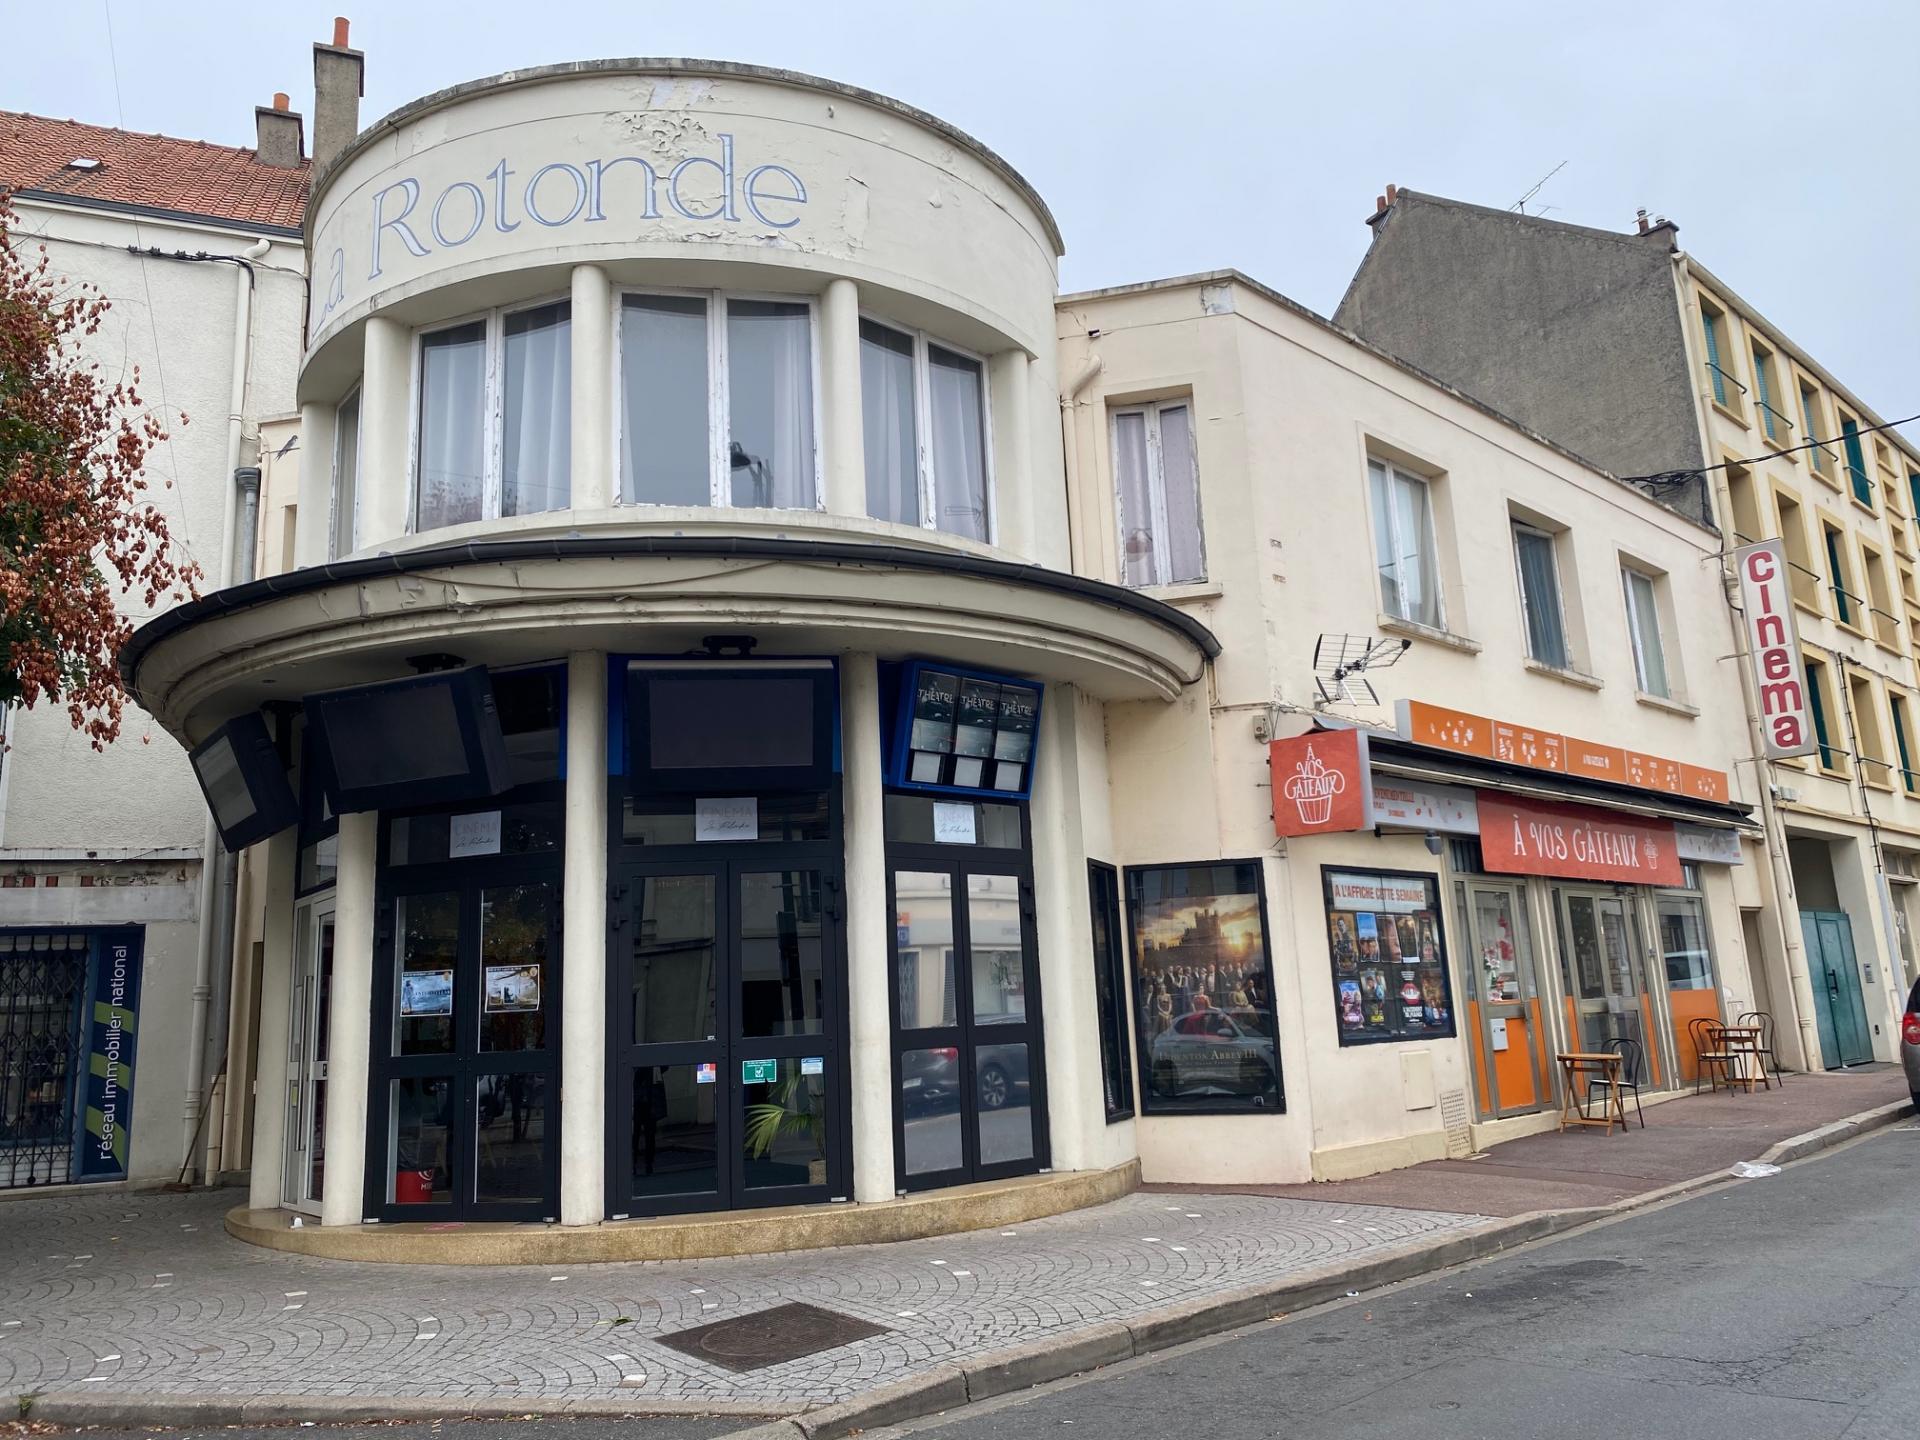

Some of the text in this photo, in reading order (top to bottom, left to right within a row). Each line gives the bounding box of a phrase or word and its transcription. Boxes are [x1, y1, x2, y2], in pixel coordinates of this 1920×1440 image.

[368, 133, 808, 281] Rotonde
[1296, 759, 1325, 779] VOS
[1513, 814, 1641, 868] À VOS GÂTEAUX
[1342, 885, 1375, 900] L'AFFICHE
[1376, 887, 1394, 901] CETTE
[1395, 889, 1424, 903] SEMAINE
[98, 945, 127, 1160] réseau immobilier national
